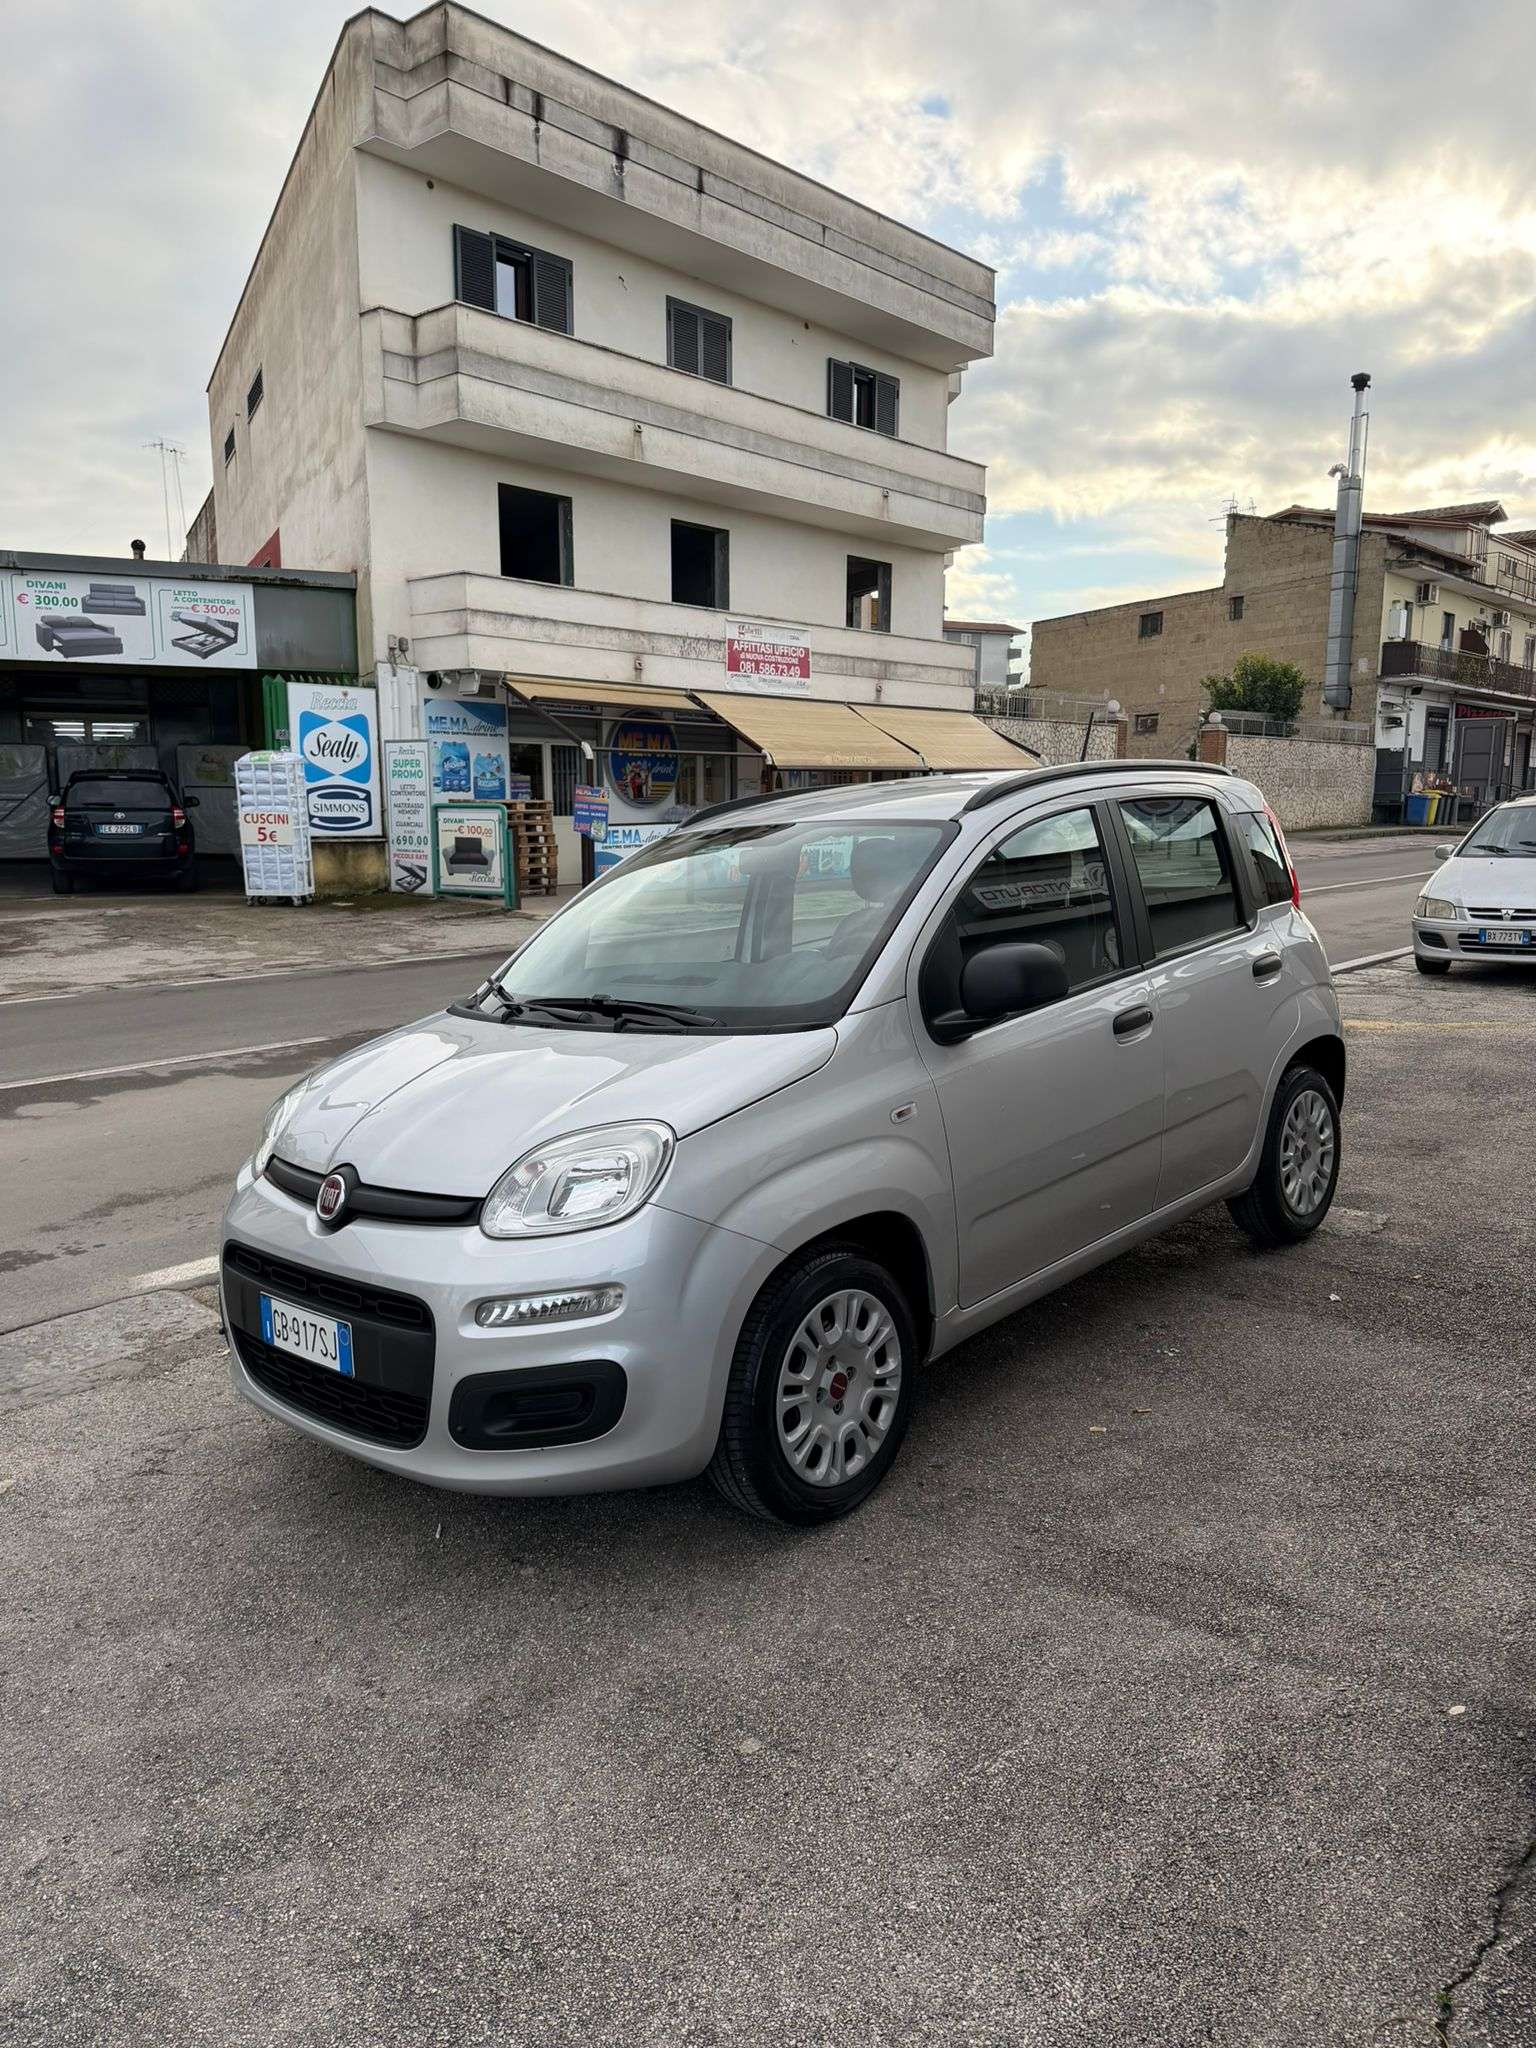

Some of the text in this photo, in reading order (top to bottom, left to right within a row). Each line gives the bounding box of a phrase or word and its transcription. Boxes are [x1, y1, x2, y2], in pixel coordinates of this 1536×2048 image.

[26, 580, 66, 589] DIVANI
[17, 593, 78, 607] € 300,00
[191, 604, 240, 615] € 300,00
[733, 640, 805, 658] AFFITTASI UFFICIO
[746, 652, 764, 660] NUOVA
[765, 655, 799, 664] COSTRUZIONE
[310, 732, 359, 763] Sealy
[392, 759, 421, 769] SUPER
[391, 769, 424, 779] PROMO
[313, 803, 365, 813] SIMMONS
[243, 813, 289, 825] CUSCINI
[443, 817, 465, 825] DIVANI
[458, 826, 465, 834] €
[466, 826, 493, 836] 100,00
[396, 835, 429, 846] 690,00
[322, 1188, 340, 1210] FIAT
